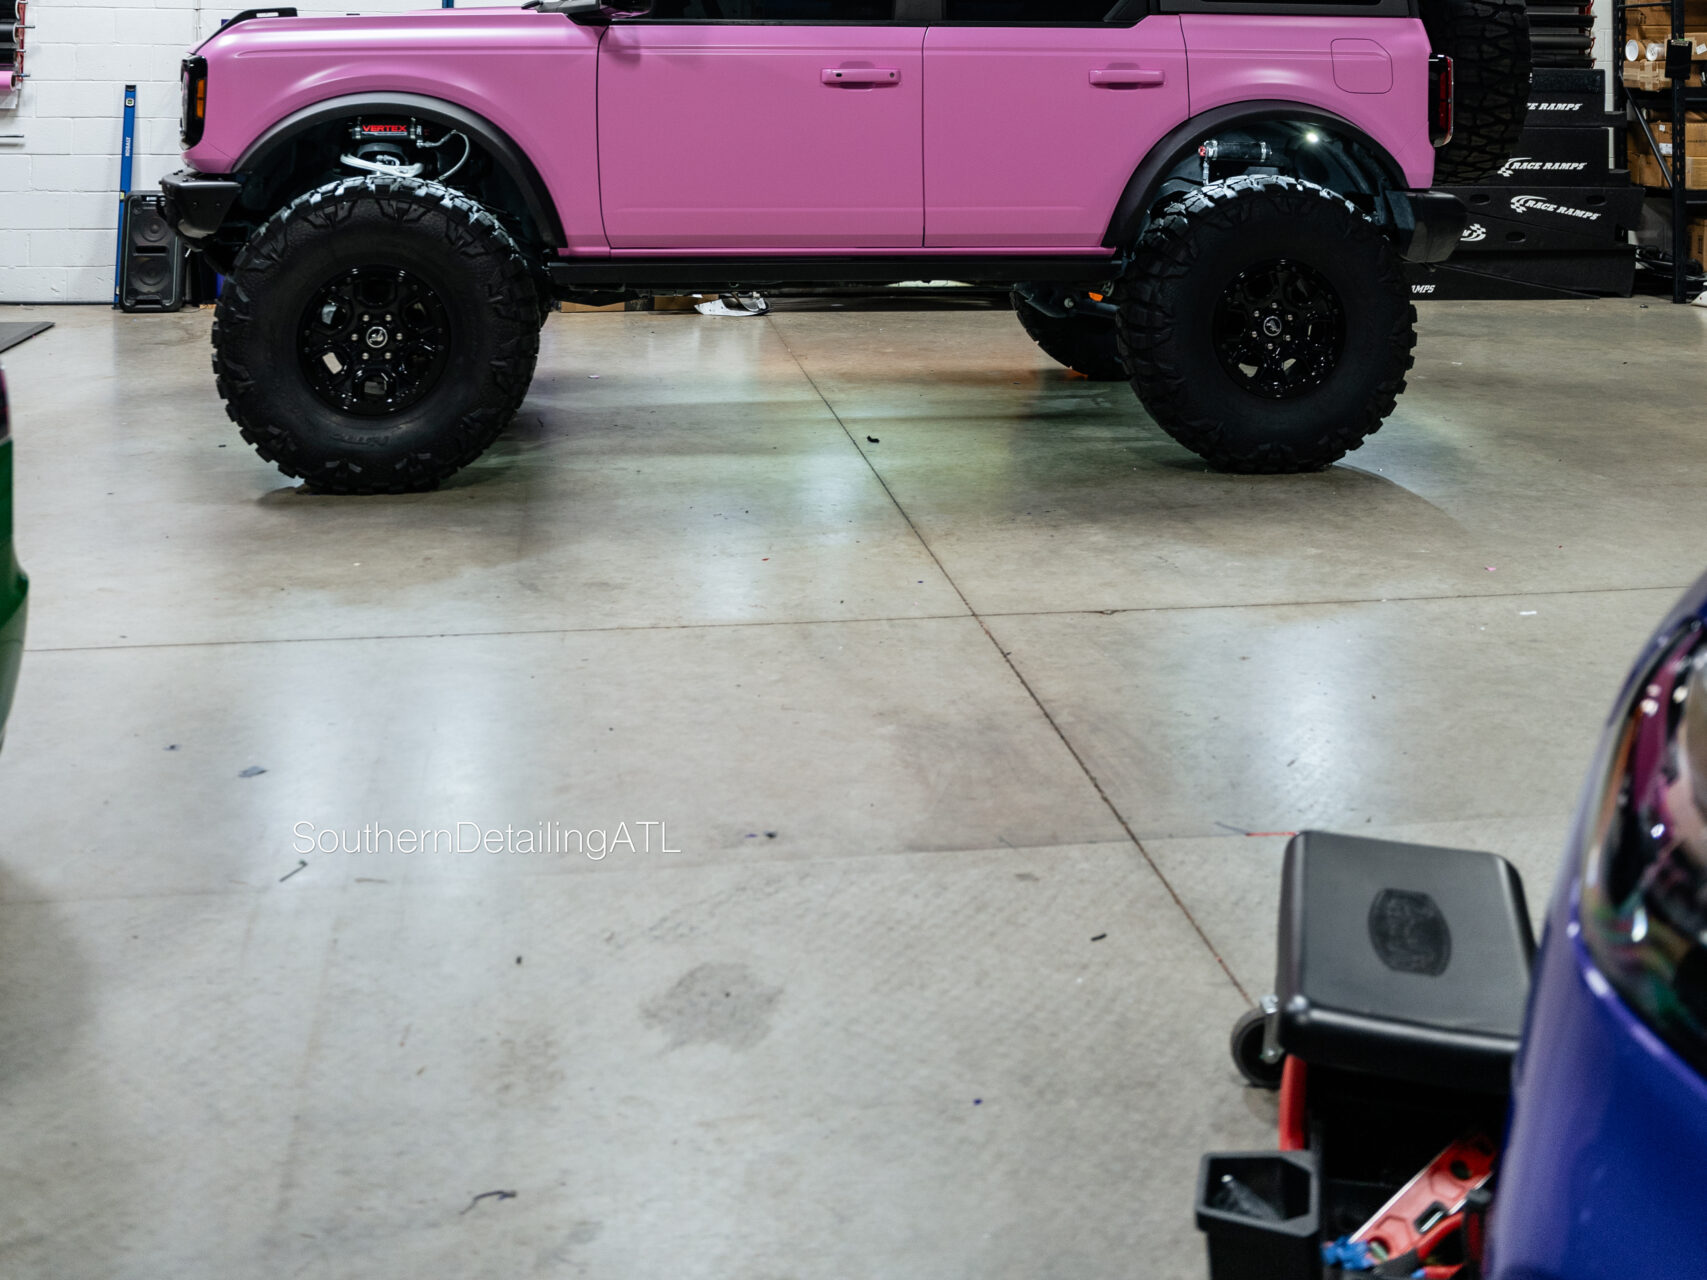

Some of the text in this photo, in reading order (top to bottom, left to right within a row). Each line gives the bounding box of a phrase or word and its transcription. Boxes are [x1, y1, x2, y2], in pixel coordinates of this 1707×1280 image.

[1538, 102, 1583, 111] RAMPS
[362, 124, 407, 132] VERTEX
[1511, 162, 1588, 170] RACE RAMPS
[1525, 199, 1602, 220] RACE RAMPS
